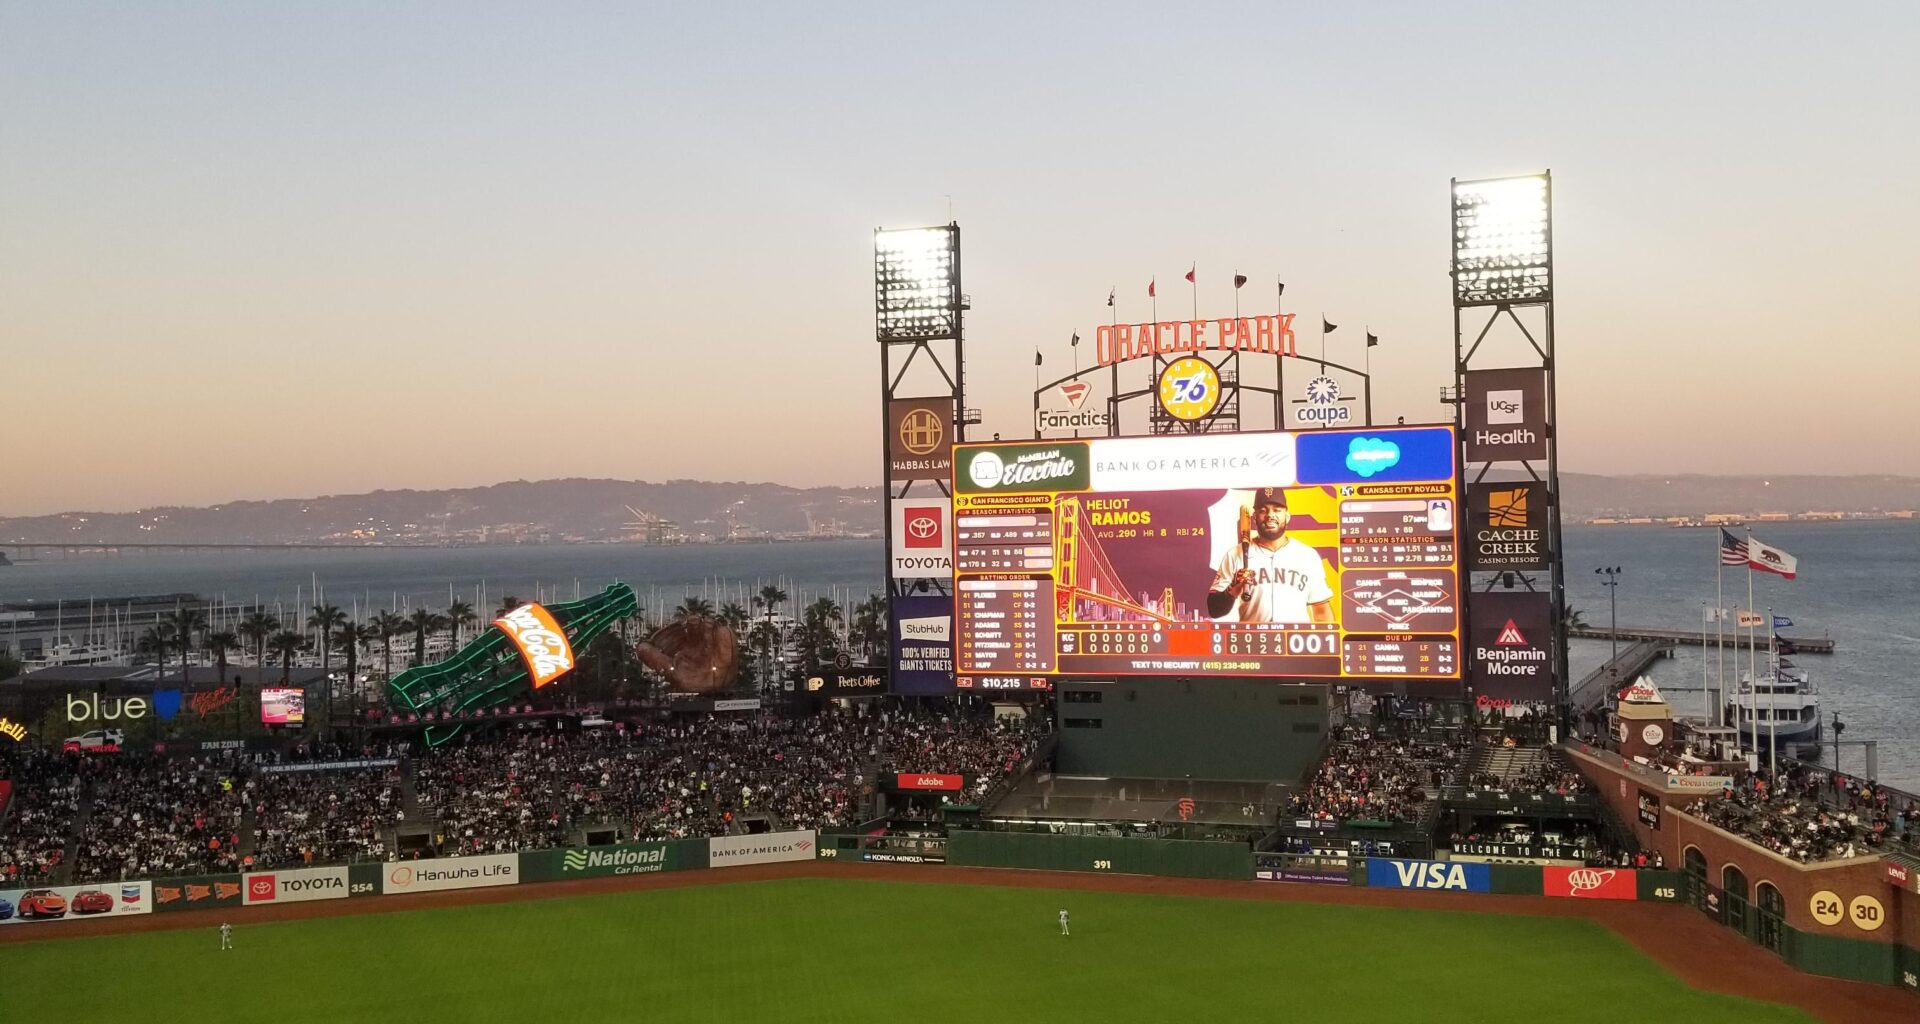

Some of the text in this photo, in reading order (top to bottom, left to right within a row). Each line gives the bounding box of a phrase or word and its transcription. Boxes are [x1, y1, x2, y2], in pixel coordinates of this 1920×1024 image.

[1096, 313, 1298, 367] ORACLE PARK
[1173, 370, 1207, 403] 76
[1490, 400, 1520, 414] UCSF
[1039, 409, 1110, 428] Fanatics
[1297, 407, 1349, 424] coupa
[1476, 428, 1536, 445] Health
[892, 459, 951, 470] HABBAS LAW
[1003, 456, 1075, 486] Electric
[1096, 456, 1251, 473] BANK OF AMERICA
[1363, 485, 1446, 495] KANSAS CITY ROYALS
[972, 496, 1050, 505] SAN FRANCISCO GIANTS
[1086, 498, 1130, 511] HELIOT
[998, 507, 1036, 515] STATISTICS
[1091, 510, 1152, 526] RAMOS
[1098, 530, 1114, 539] AVG
[1115, 529, 1137, 538] .290
[1160, 528, 1167, 537] 8
[1176, 528, 1189, 536] RBI
[1191, 527, 1205, 536] 24
[1477, 529, 1540, 542] CACHE
[1479, 542, 1538, 555] CREEK
[895, 557, 952, 569] TOYOTA
[906, 624, 944, 635] StubHub
[1061, 632, 1282, 643] KC 0 0 0 0 0 0 0 5 0 5 4
[1289, 634, 1335, 654] 0 0 1
[902, 647, 950, 659] 100% VERIFIED
[1063, 643, 1074, 652] SF
[1090, 643, 1098, 653] 0
[1102, 643, 1111, 653] 0
[1115, 643, 1123, 653] 0
[1128, 643, 1136, 653] 0
[1141, 643, 1149, 653] 0
[1213, 643, 1222, 654] 0
[1230, 644, 1238, 654] 0
[1259, 644, 1268, 654] 2
[1274, 644, 1282, 654] 4
[1476, 647, 1547, 664] Benjamin
[900, 660, 952, 671] GIANTS TICKETS
[1131, 661, 1151, 669] TEXT
[1152, 661, 1162, 669] TO
[1487, 662, 1537, 675] Moore
[858, 675, 881, 687] Coffee
[982, 677, 1021, 690] $10,215
[67, 692, 147, 722] blue
[1475, 694, 1514, 709] Coors
[201, 739, 246, 750] FAN ZONE
[917, 776, 944, 787] Adobe
[587, 846, 667, 868] National
[712, 845, 793, 858] BANK OF AMERICA
[820, 848, 837, 857] 399
[1453, 844, 1506, 855] WELCOME
[1517, 846, 1530, 856] TO
[1541, 847, 1561, 857] THE
[872, 854, 924, 863] KONICA MINOLTA
[1093, 860, 1111, 869] 391
[415, 864, 512, 882] Hanwha Life
[614, 863, 663, 875] Car Rental
[1389, 860, 1468, 890] VISA
[280, 877, 344, 892] TOYOTA
[1572, 869, 1599, 889] AAA
[351, 881, 374, 893] 354
[1654, 886, 1676, 898] 415
[1815, 900, 1878, 921] 24 30
